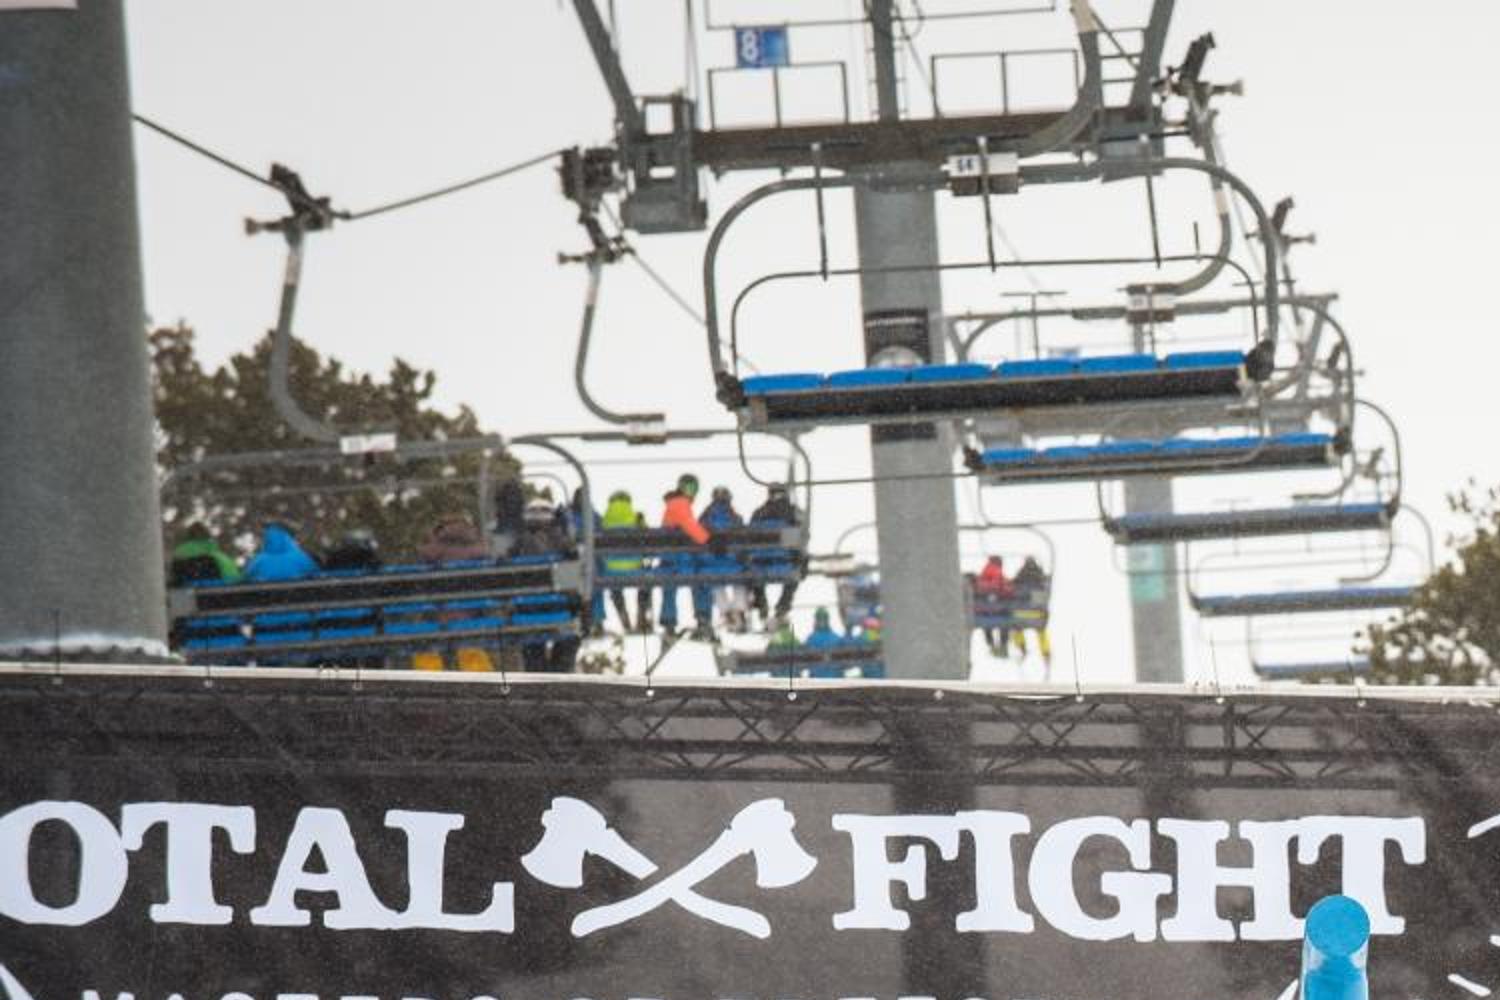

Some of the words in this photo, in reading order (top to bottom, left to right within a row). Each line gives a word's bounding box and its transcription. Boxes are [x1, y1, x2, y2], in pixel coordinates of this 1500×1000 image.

[741, 29, 758, 62] 8
[0, 800, 515, 933] OTAL
[832, 811, 1426, 942] FIGHT
